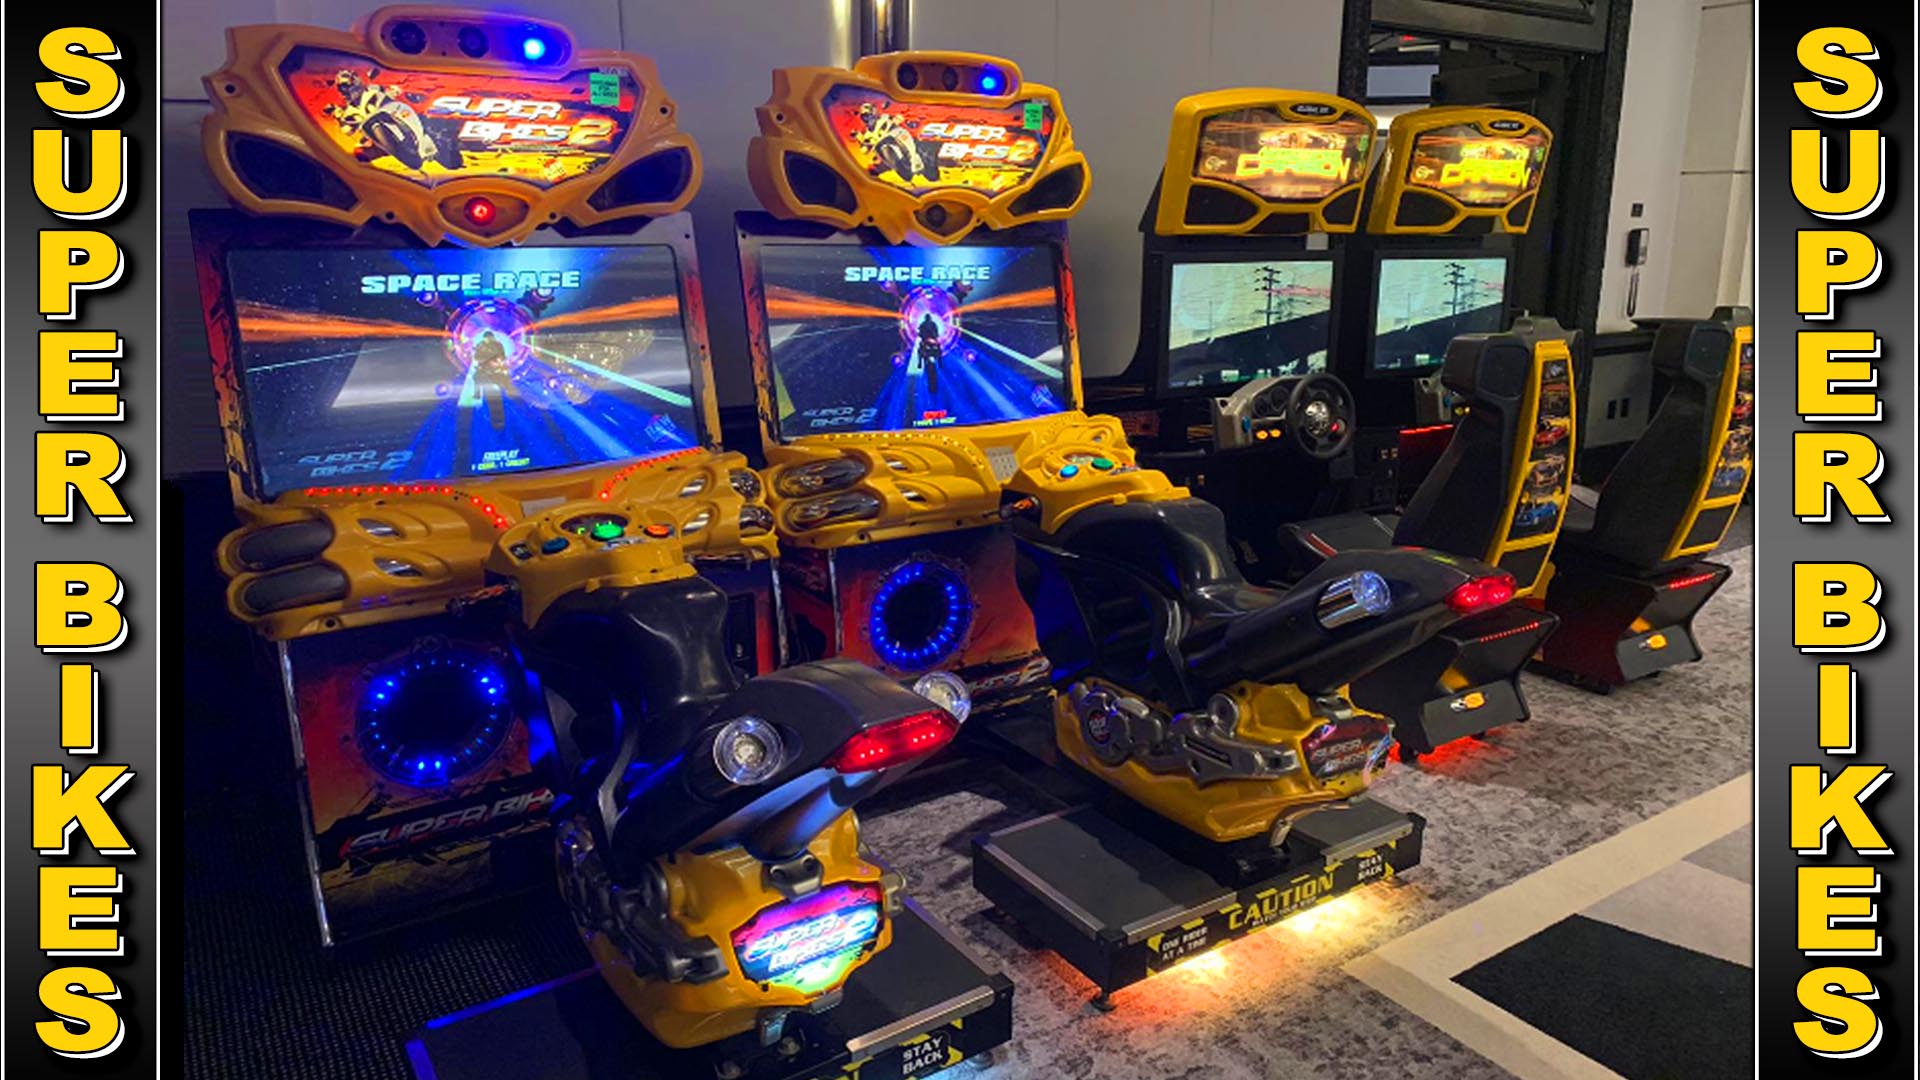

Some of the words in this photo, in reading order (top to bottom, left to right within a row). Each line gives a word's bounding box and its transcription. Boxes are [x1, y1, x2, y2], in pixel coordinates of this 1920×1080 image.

[428, 96, 562, 120] SUPER
[458, 121, 572, 144] BIKES
[568, 118, 613, 145] 2
[920, 123, 1007, 140] SUPER
[1006, 139, 1037, 161] 2
[361, 273, 481, 294] SPACE
[494, 270, 580, 289] RACE
[844, 266, 922, 282] SPACE
[931, 265, 990, 280] RACE
[380, 449, 414, 471] 2
[341, 803, 492, 853] SUPER
[491, 788, 556, 818] BIK
[1228, 872, 1335, 931] CAUTION
[902, 1035, 944, 1062] STAY
[902, 1049, 944, 1076] BACK
